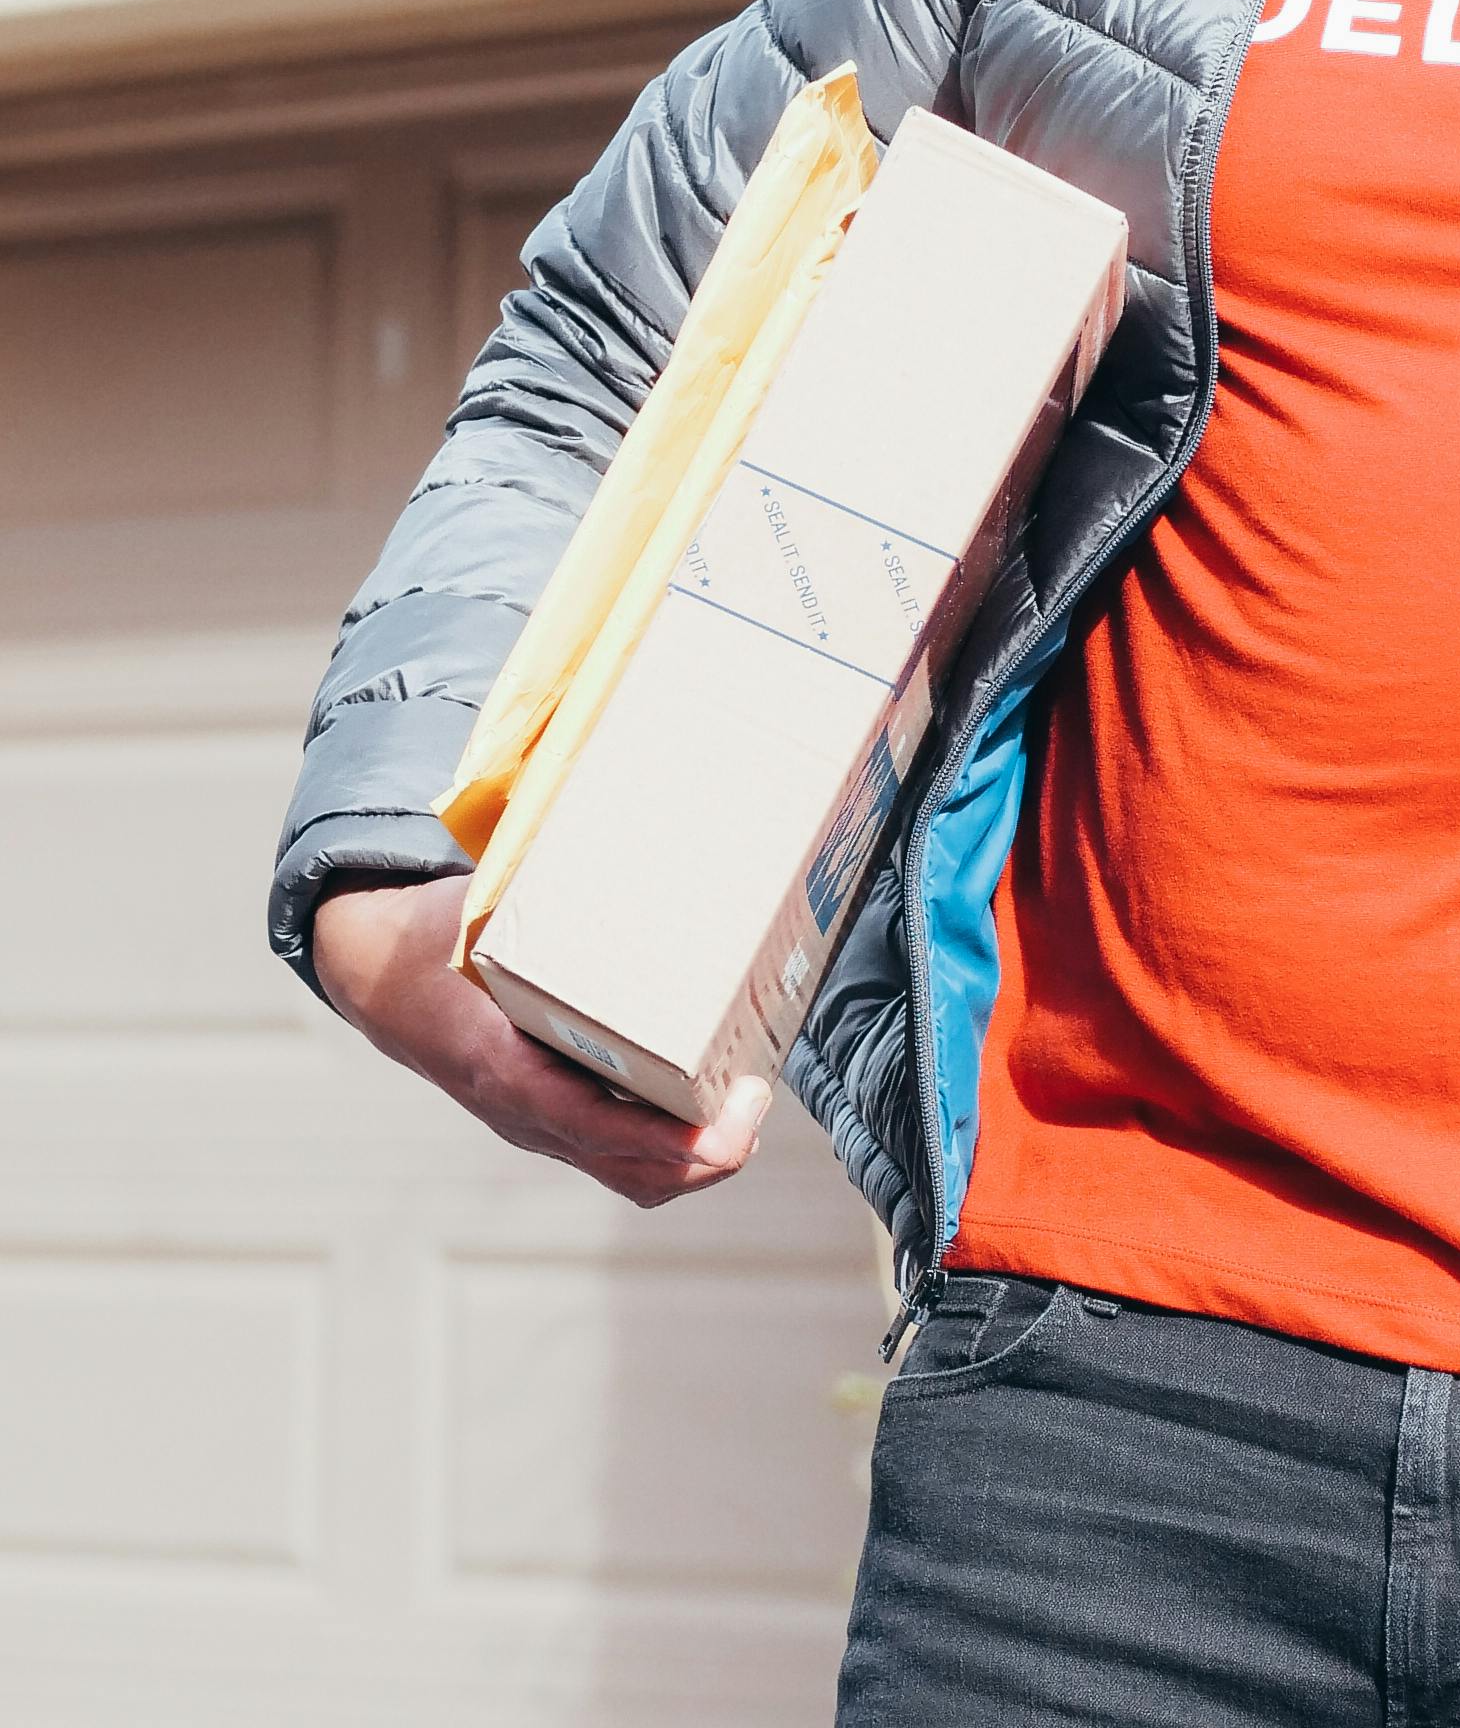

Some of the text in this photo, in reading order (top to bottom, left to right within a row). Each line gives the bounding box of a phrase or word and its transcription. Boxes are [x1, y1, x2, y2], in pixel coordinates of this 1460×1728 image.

[764, 500, 791, 543] SEAL
[789, 565, 818, 609] SEND
[884, 555, 911, 597] SEAL
